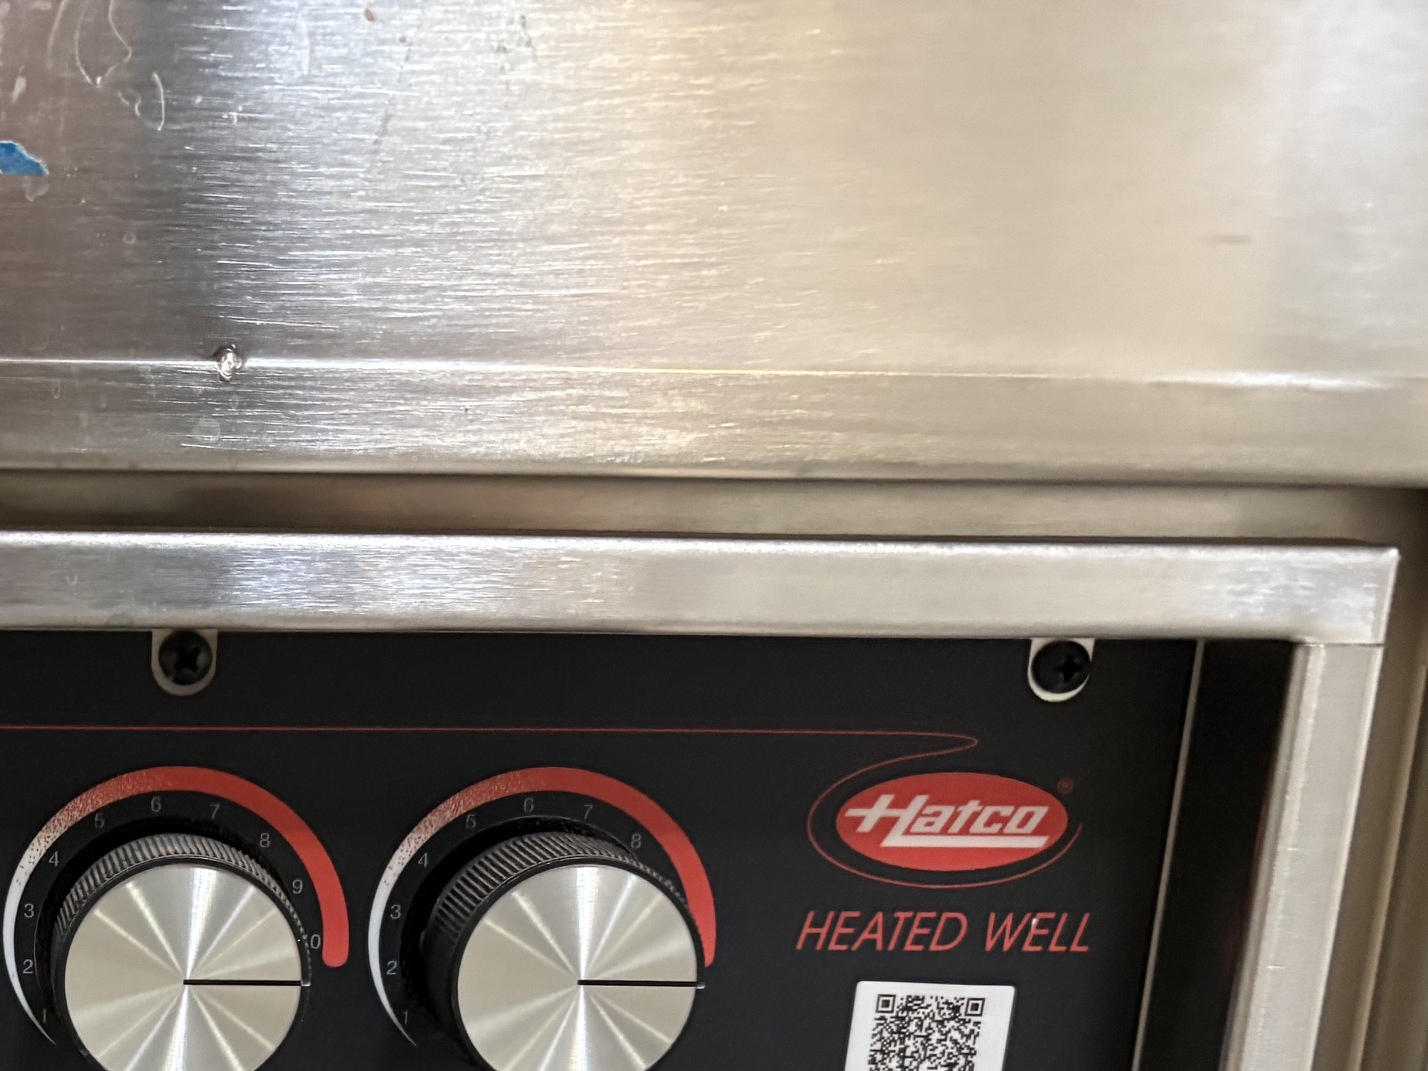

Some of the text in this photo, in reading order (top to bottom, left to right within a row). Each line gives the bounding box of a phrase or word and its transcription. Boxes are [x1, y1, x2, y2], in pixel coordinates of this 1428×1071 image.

[151, 797, 161, 812] 6
[211, 803, 220, 818] 7
[524, 798, 534, 812] 6
[584, 805, 593, 819] 7
[94, 813, 105, 829] 5
[464, 814, 477, 829] 5
[845, 794, 1049, 848] Hatco
[260, 833, 270, 847] 8
[630, 833, 642, 849] 8
[48, 851, 60, 867] 4
[417, 852, 429, 868] 4
[293, 880, 302, 894] 9
[24, 904, 34, 918] 3
[390, 904, 401, 919] 3
[797, 912, 1089, 951] HEATED WELL
[23, 959, 34, 974] 2
[387, 961, 397, 974] 2
